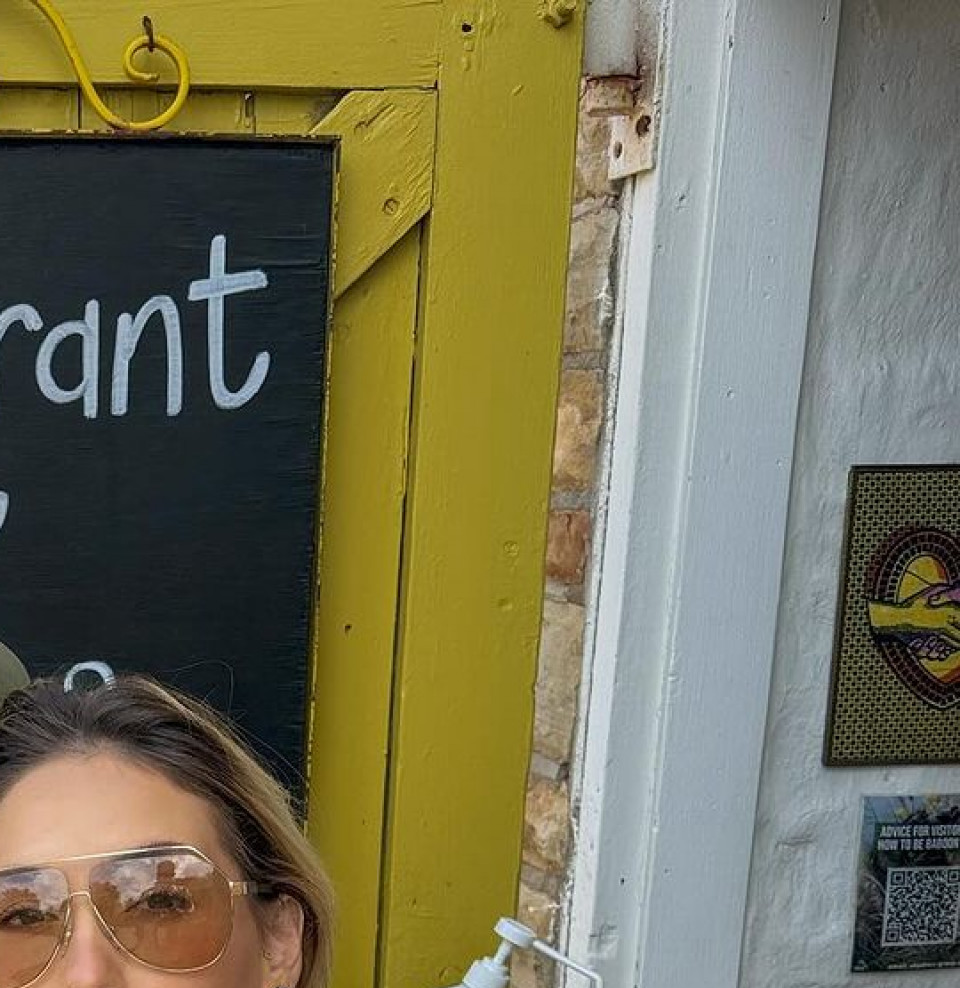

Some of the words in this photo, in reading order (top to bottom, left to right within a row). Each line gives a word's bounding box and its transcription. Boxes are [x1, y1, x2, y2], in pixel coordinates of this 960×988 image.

[880, 824, 912, 838] ADVICE
[901, 838, 911, 851] TO
[913, 838, 925, 851] BE
